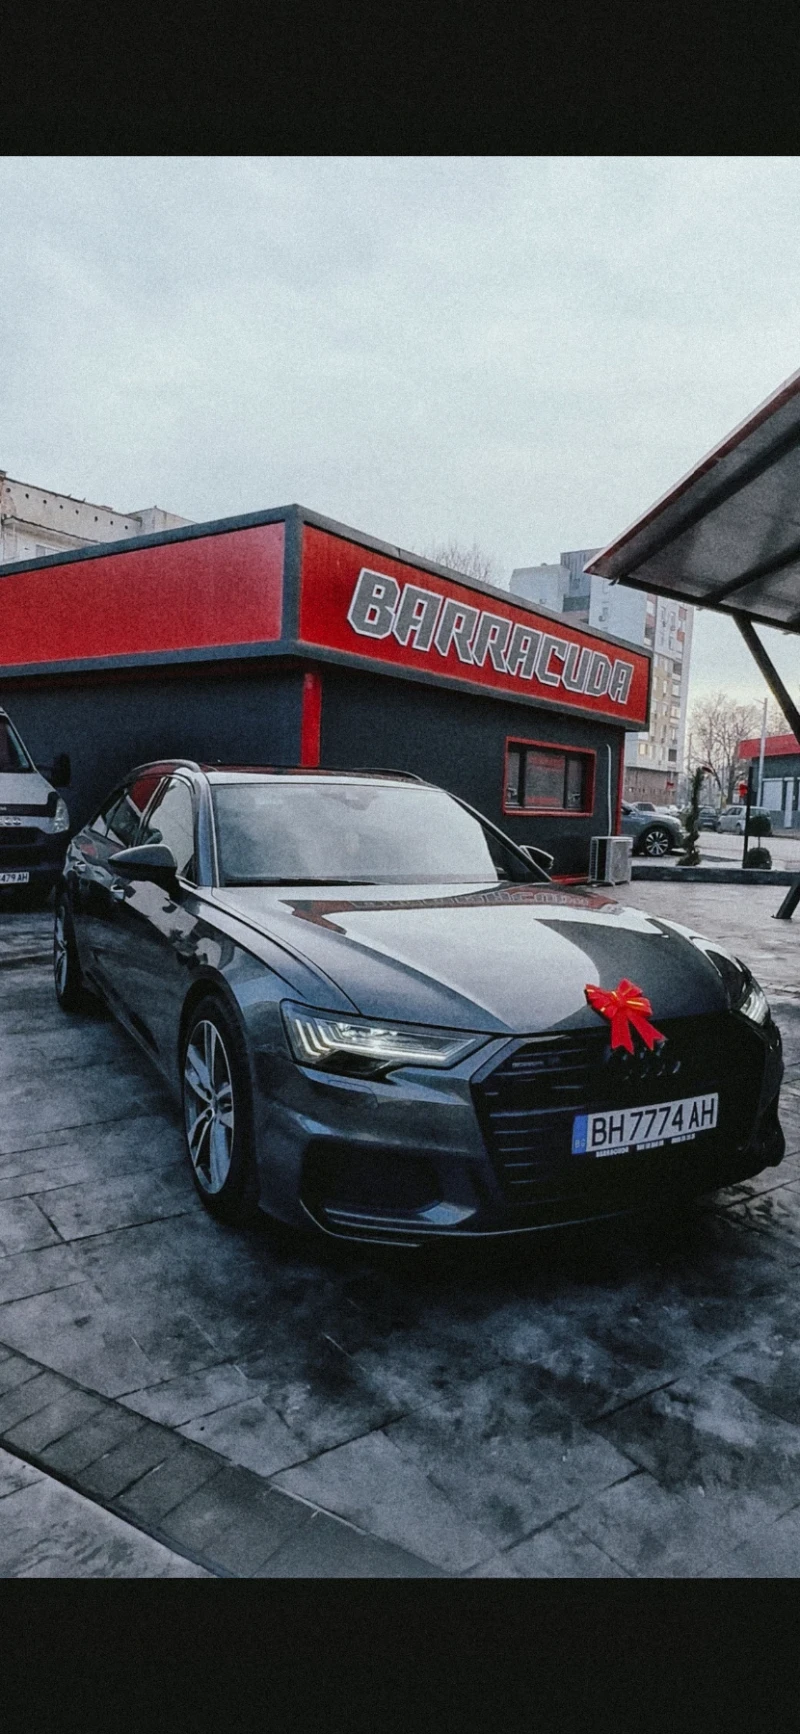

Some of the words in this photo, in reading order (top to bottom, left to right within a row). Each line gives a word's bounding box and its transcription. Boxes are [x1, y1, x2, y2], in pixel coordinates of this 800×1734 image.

[347, 567, 634, 704] BARRACUDA
[0, 873, 16, 882] 479
[592, 1114, 625, 1147] BH
[630, 1104, 683, 1140] 7774
[688, 1098, 715, 1129] AH
